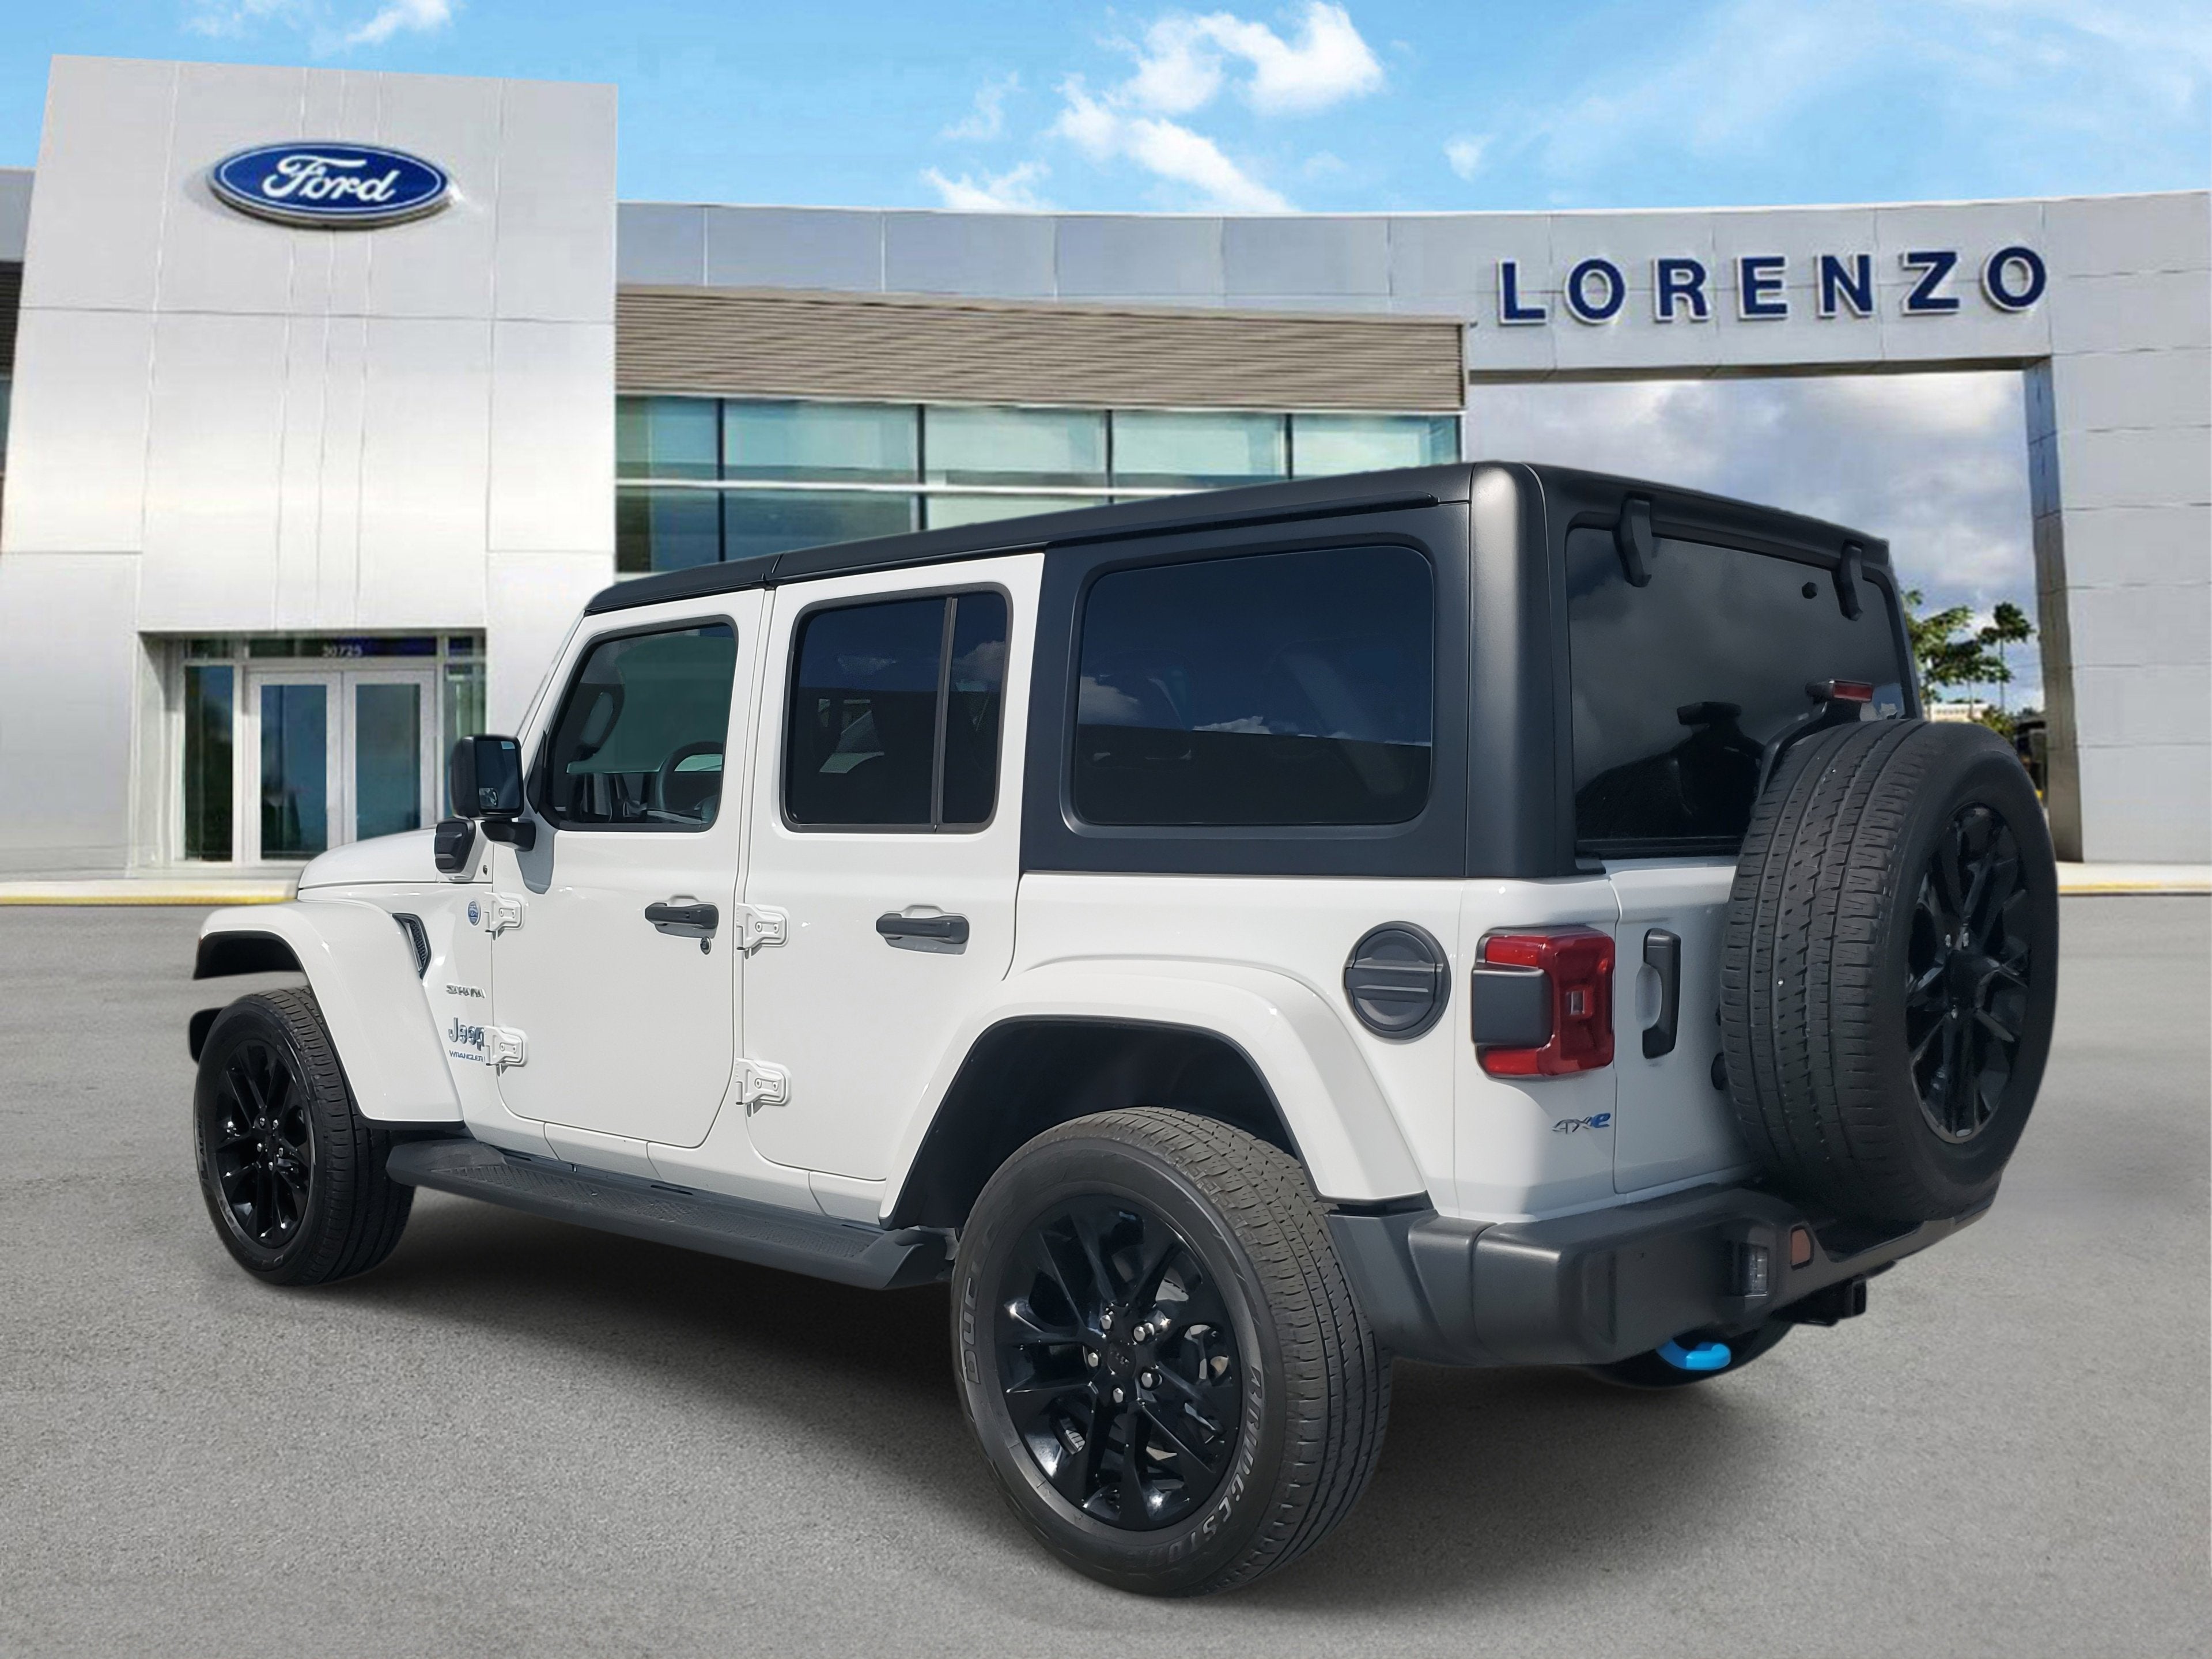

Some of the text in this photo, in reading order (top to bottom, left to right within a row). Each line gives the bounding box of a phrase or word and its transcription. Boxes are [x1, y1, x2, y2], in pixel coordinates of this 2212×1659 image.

[262, 154, 400, 202] Ford
[1498, 244, 2047, 324] LORENZO
[448, 1017, 485, 1051] Jeep
[449, 1049, 486, 1063] WRANGLER
